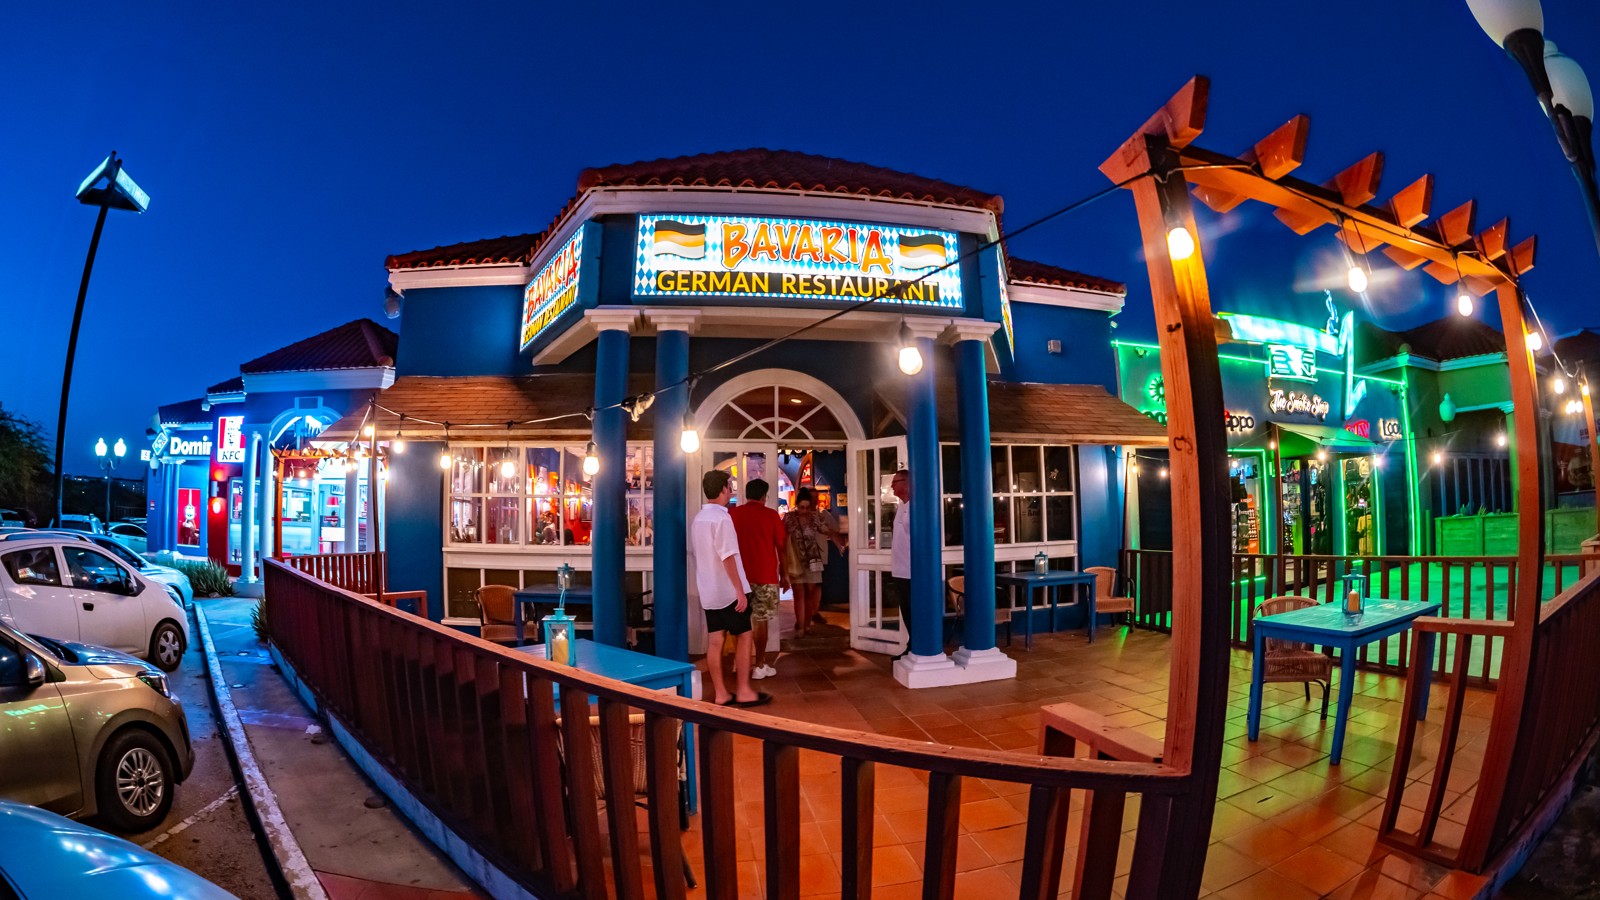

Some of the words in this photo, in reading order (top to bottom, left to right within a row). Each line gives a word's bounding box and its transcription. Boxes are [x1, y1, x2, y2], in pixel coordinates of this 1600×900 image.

[721, 222, 893, 275] BAVARIA
[526, 240, 578, 324] BAVARIA
[657, 270, 769, 293] GERMAN
[1269, 388, 1287, 414] The
[1287, 390, 1311, 413] Smoke
[221, 450, 241, 461] KFC
